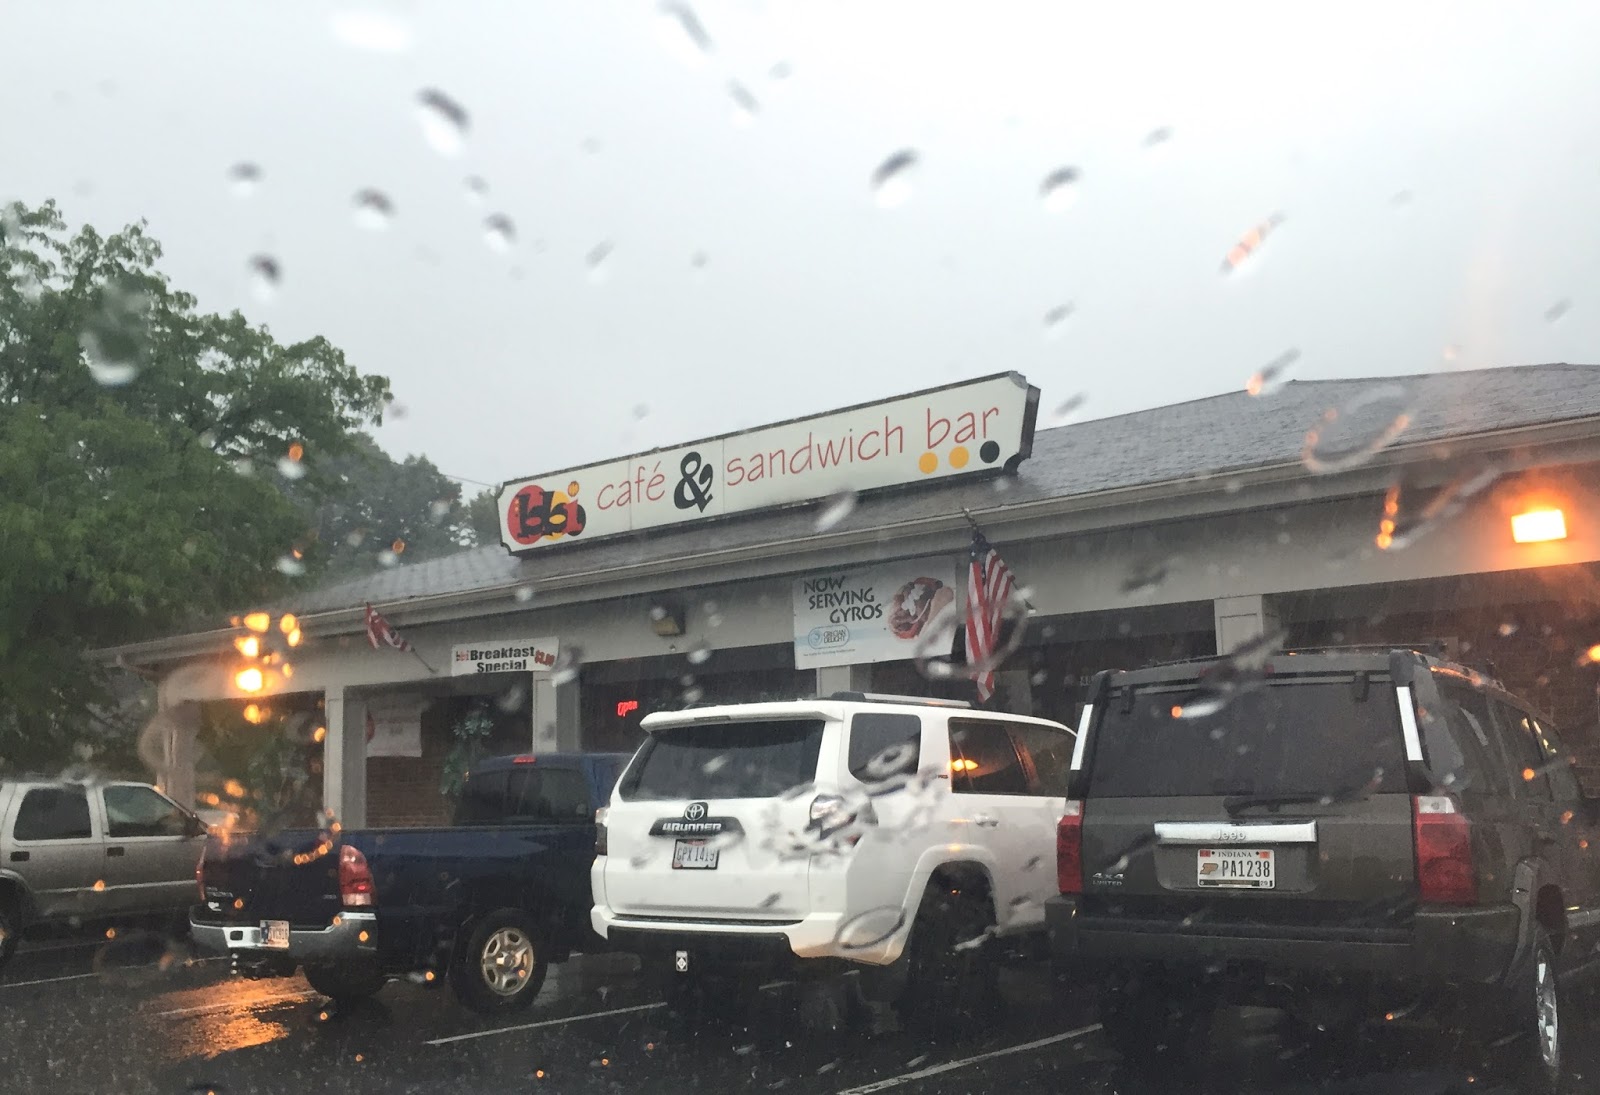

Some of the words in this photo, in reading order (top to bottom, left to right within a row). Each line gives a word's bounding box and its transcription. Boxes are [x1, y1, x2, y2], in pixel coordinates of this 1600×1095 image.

[597, 461, 665, 510] café
[674, 451, 713, 513] &
[726, 416, 903, 486] sandwich
[927, 407, 999, 450] bar
[803, 576, 846, 594] NOW
[809, 587, 875, 610] SERVING
[829, 604, 883, 624] GYROS
[470, 646, 535, 661] Breakfast
[476, 659, 527, 673] Special
[1213, 829, 1247, 841] Jeep
[1222, 860, 1270, 878] PA1238
